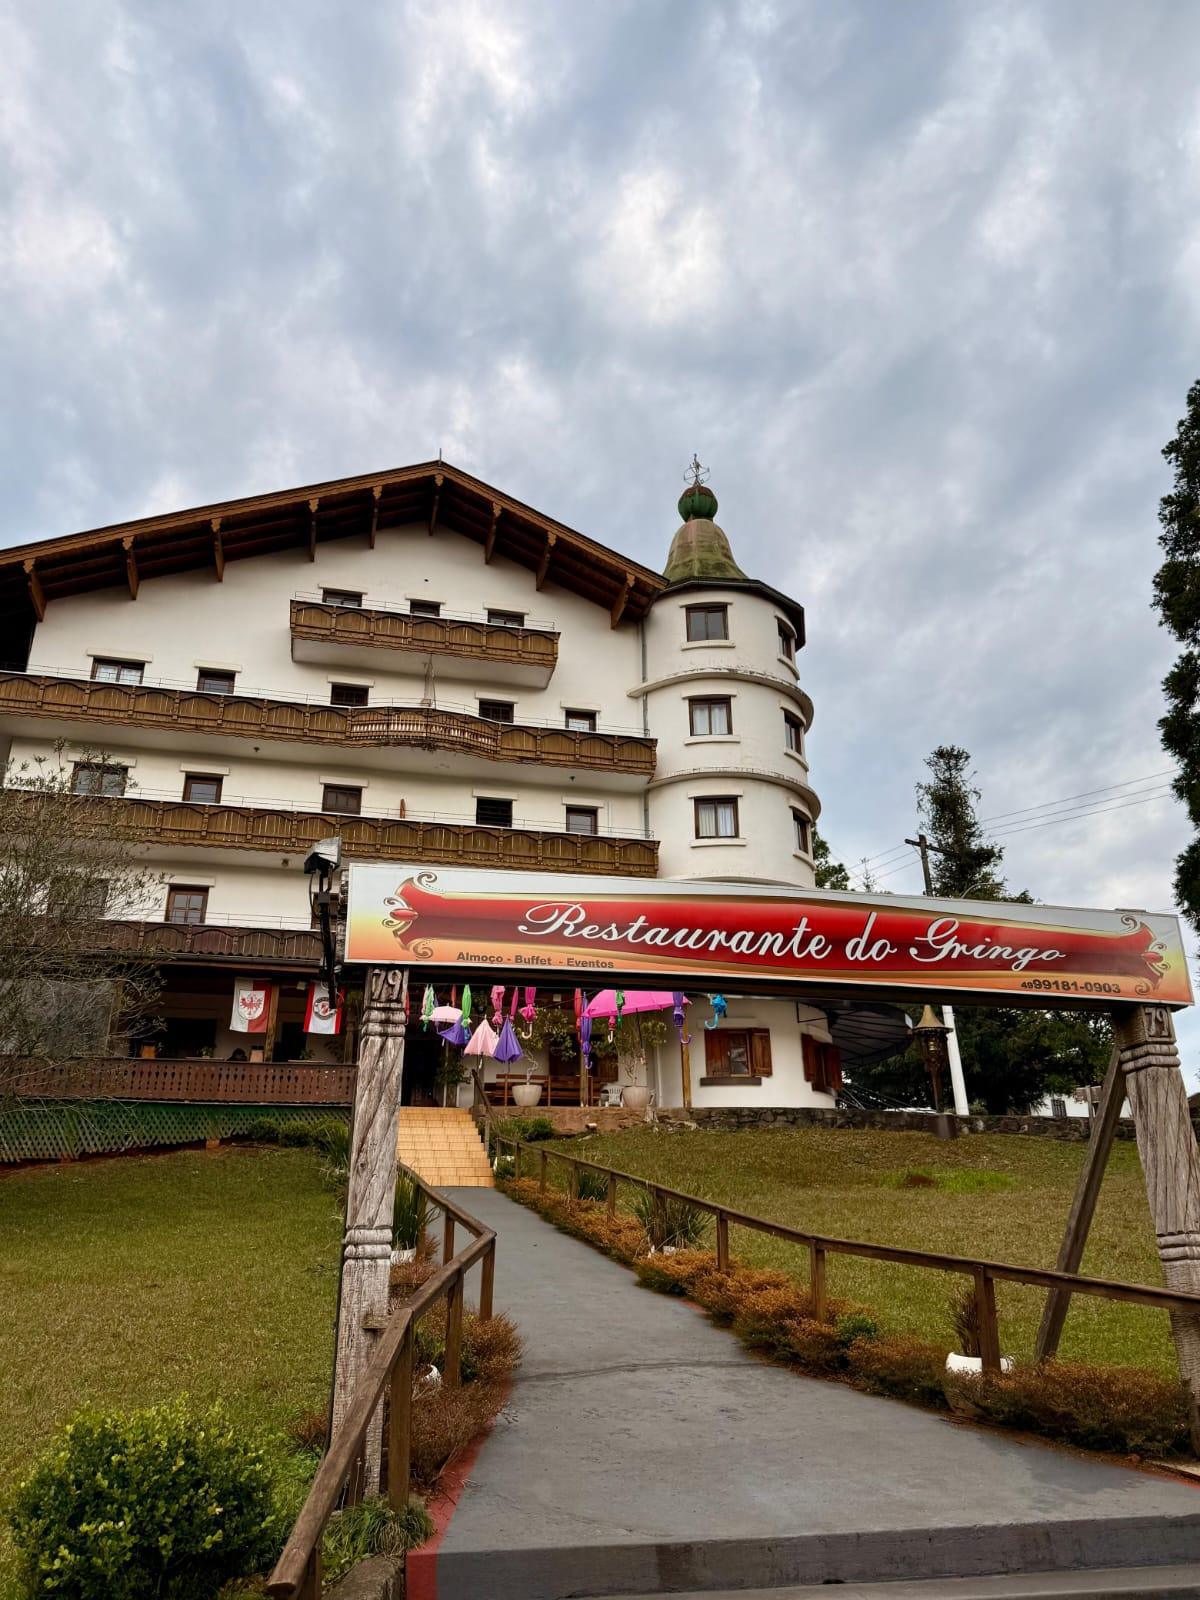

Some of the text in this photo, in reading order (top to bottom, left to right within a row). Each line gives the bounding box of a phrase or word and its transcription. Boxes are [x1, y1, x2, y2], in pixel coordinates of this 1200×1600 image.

[517, 902, 1067, 972] Restaurante do Gringo
[456, 951, 504, 965] Almoço
[514, 954, 552, 967] Buffet
[566, 957, 615, 969] Eventos
[372, 968, 403, 1000] 79
[1144, 1008, 1169, 1037] 79
